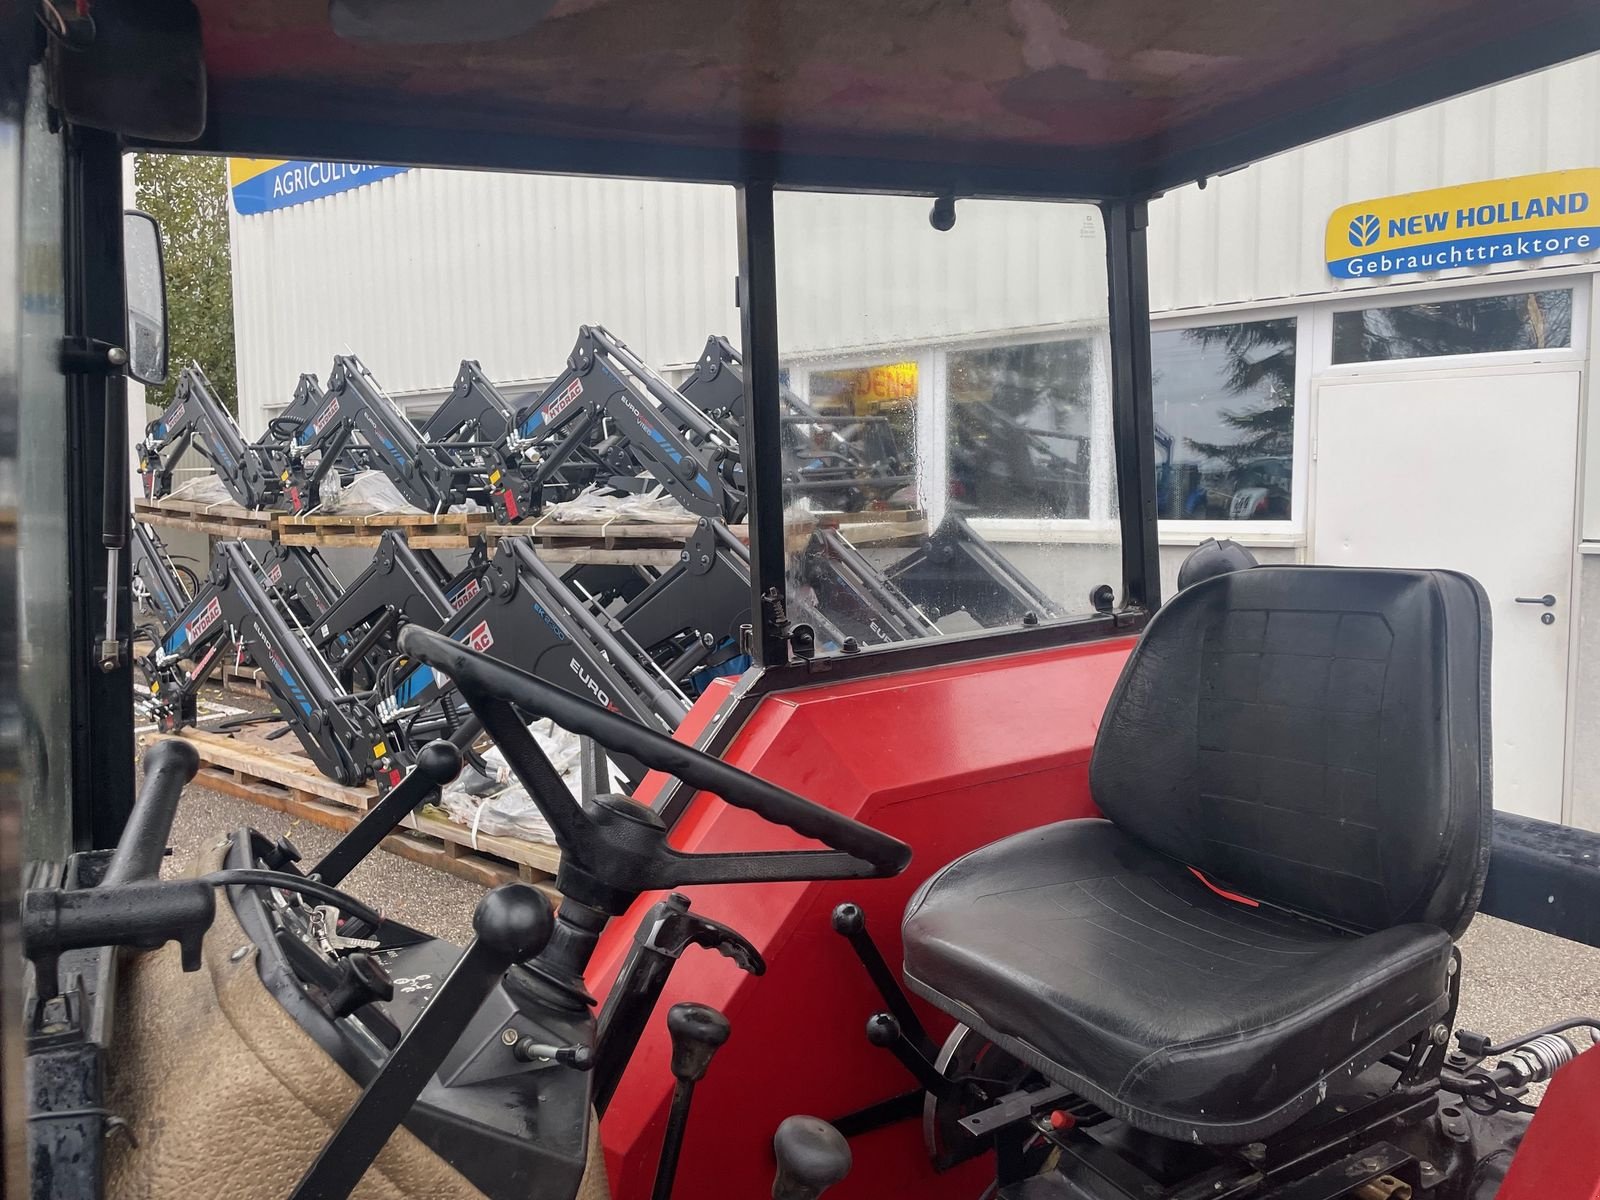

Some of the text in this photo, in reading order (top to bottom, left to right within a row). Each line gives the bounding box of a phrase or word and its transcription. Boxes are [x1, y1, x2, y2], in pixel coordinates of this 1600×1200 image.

[1388, 191, 1589, 239] NEW HOLLAND
[1347, 234, 1591, 276] Gebrauchttraktore
[549, 385, 582, 419] HYDRAC
[452, 587, 479, 611] YDRAC
[192, 605, 221, 641] HYDRAC
